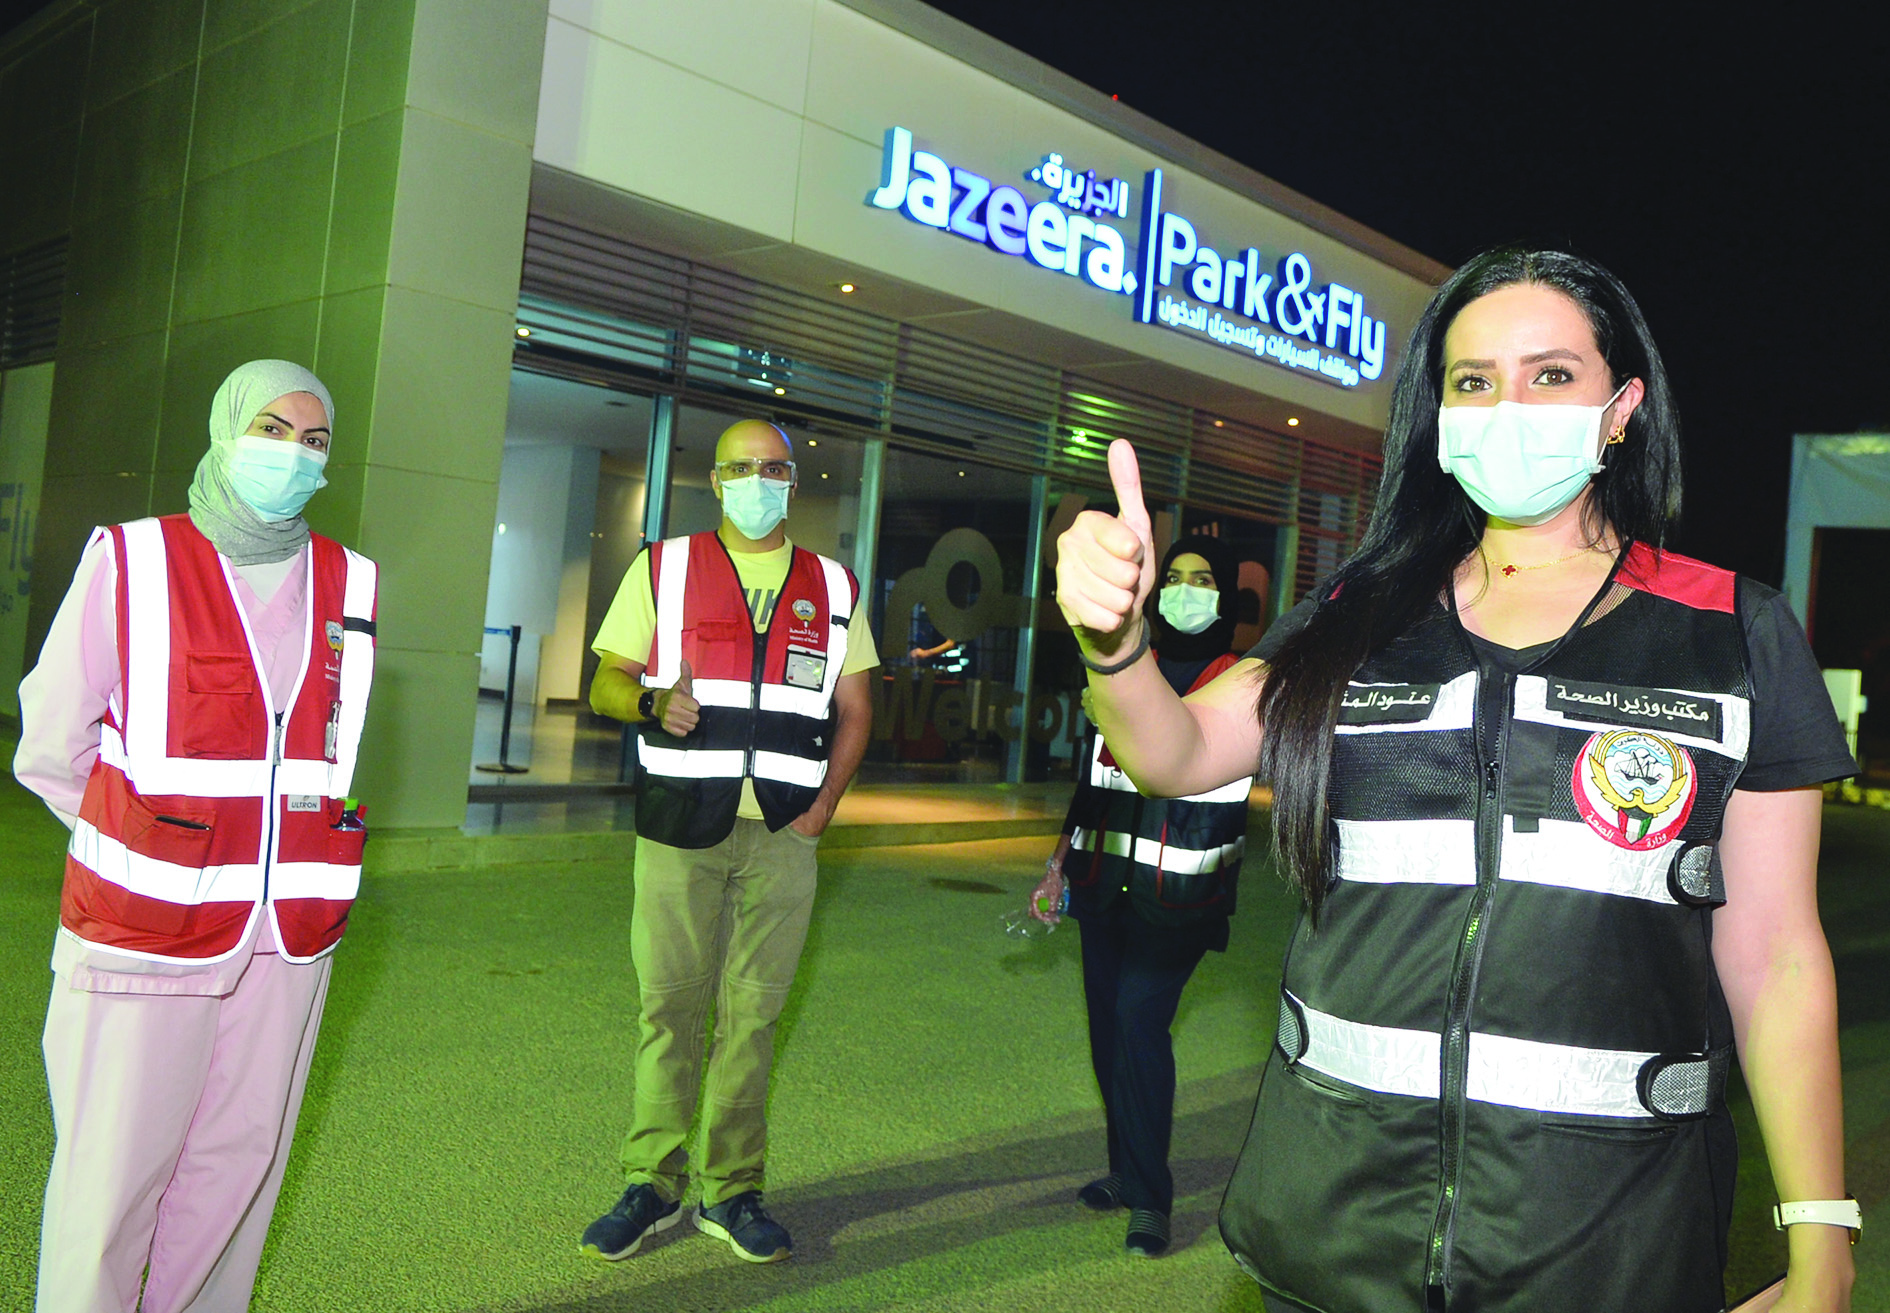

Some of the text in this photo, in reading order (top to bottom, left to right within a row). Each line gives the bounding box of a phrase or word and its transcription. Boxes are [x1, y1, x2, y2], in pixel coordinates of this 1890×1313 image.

[869, 665, 1088, 743] Welco
[1554, 684, 1710, 722] مكتب وزير الصحة
